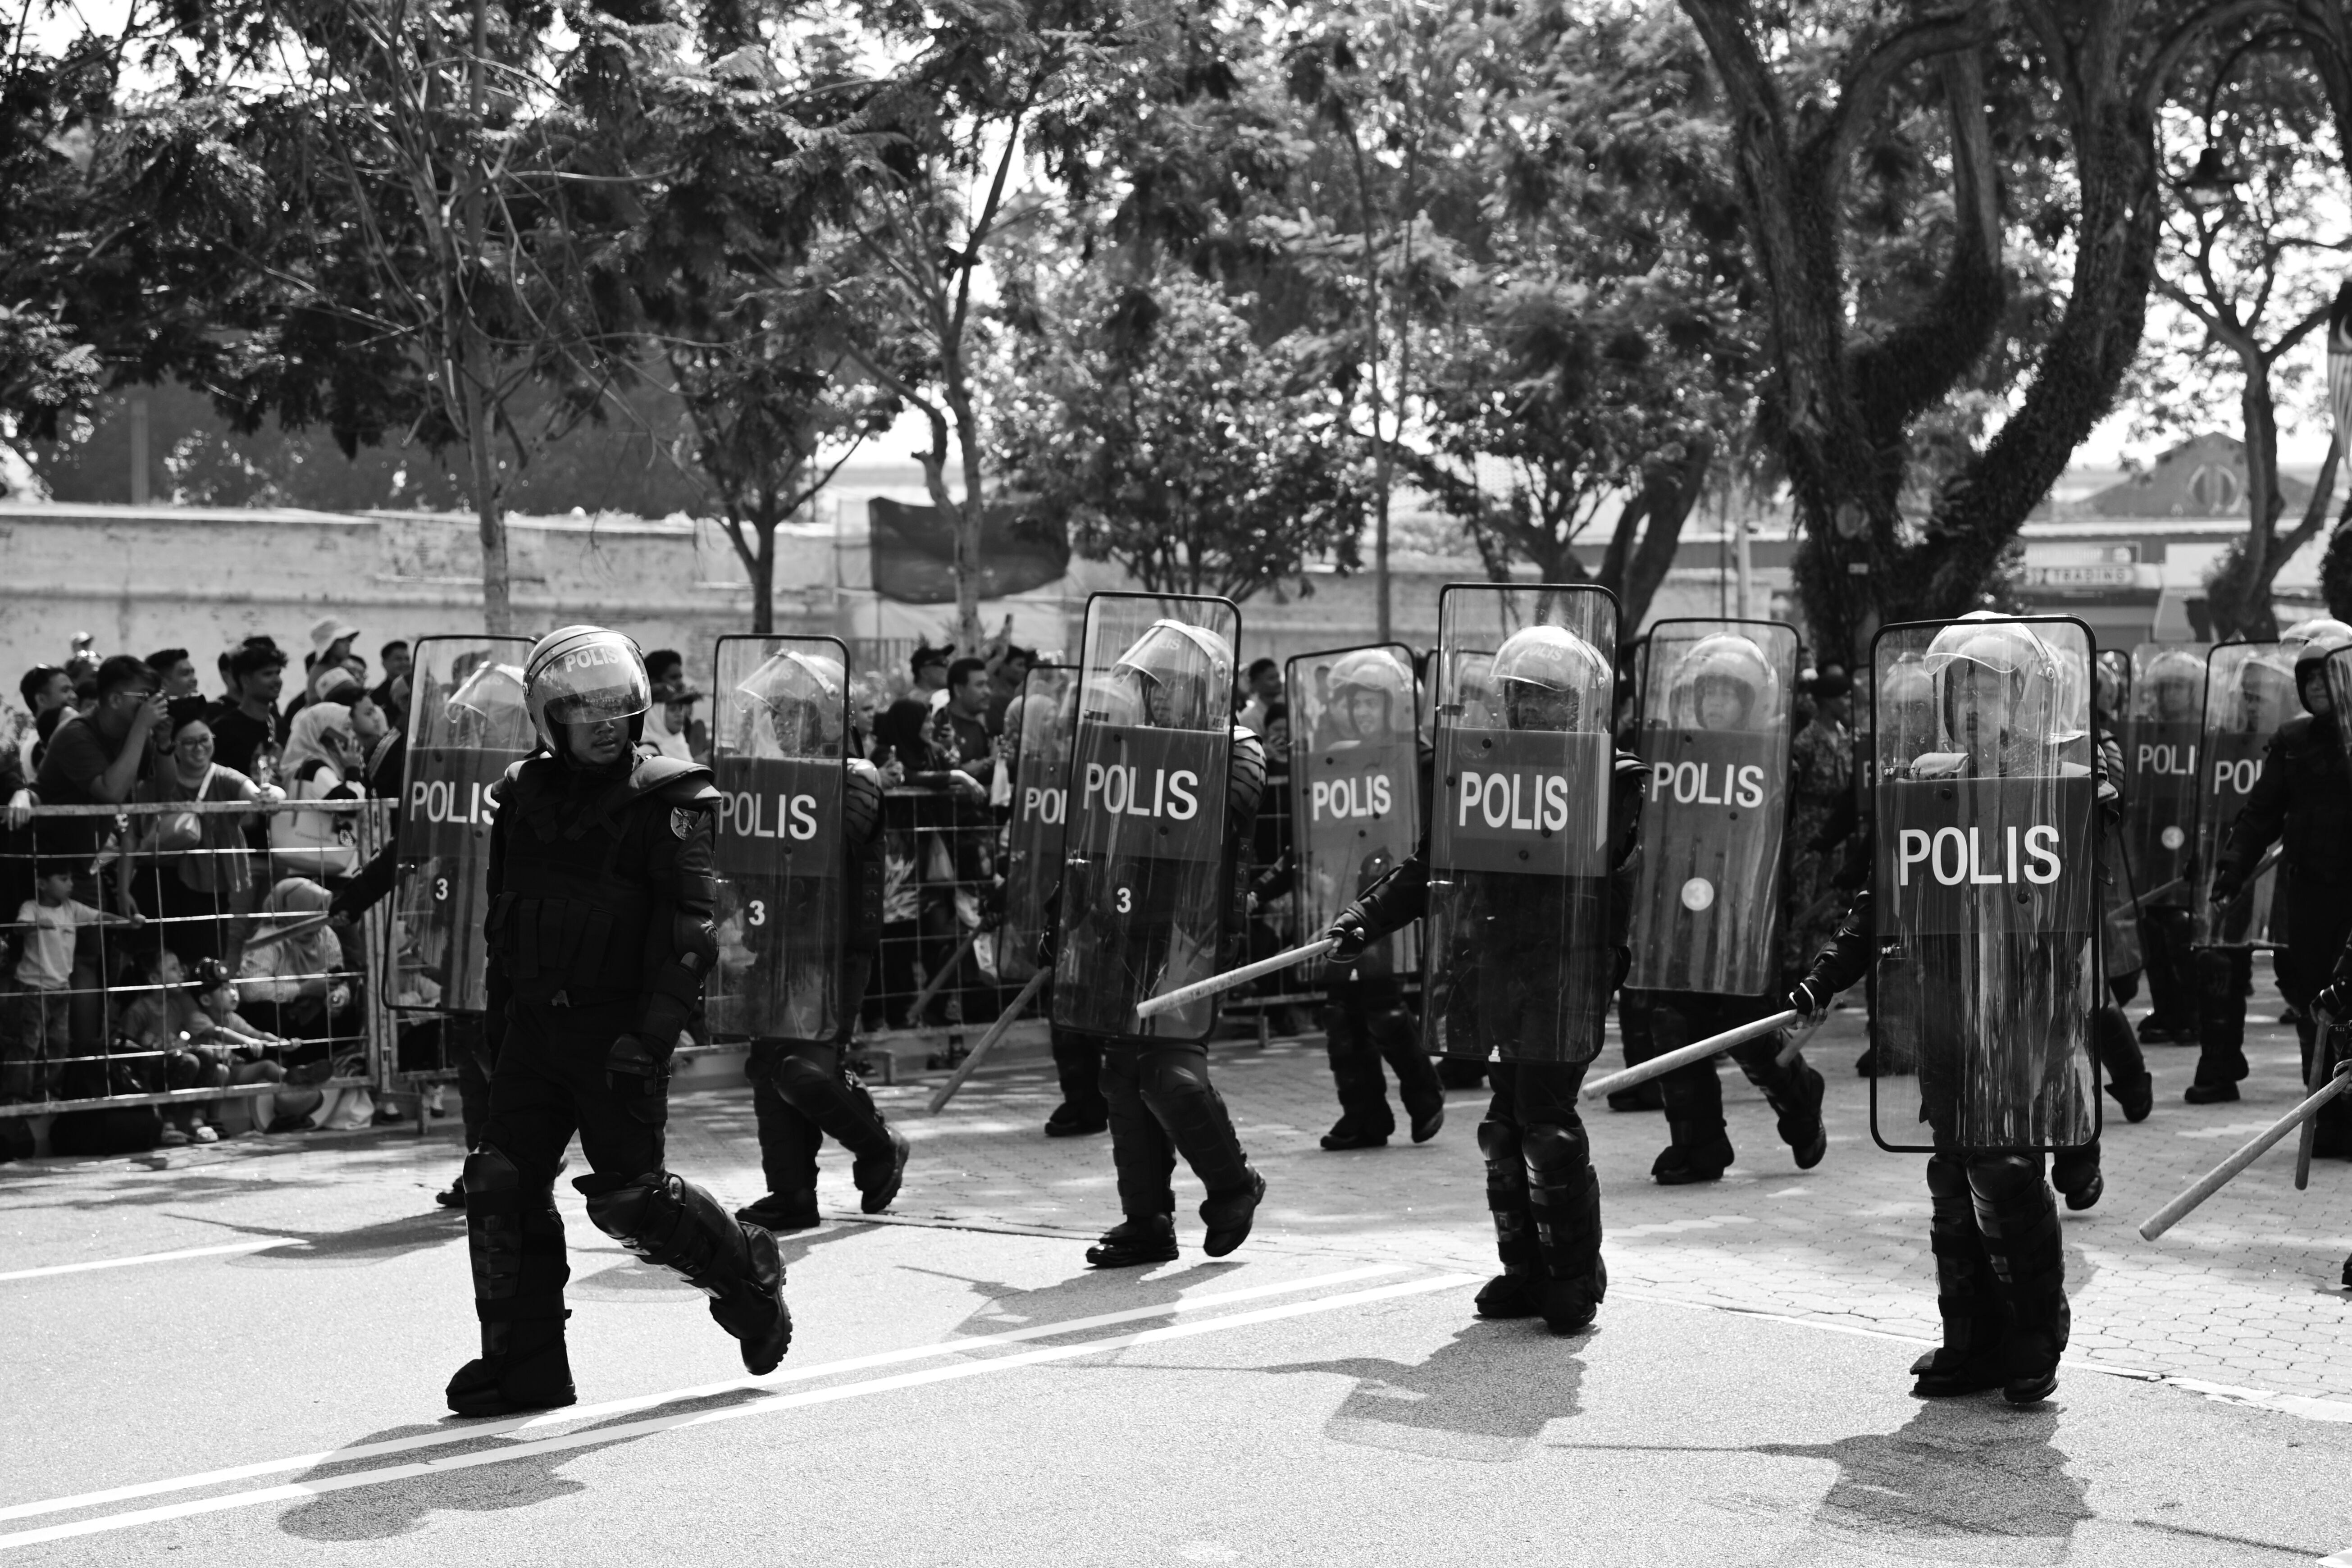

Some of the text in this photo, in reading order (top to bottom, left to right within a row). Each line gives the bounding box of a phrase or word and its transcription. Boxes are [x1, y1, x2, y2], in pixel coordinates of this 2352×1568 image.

[564, 647, 619, 673] POLIS
[1083, 762, 1198, 820] POLIS
[1312, 774, 1391, 821] POLIS
[1459, 771, 1568, 831] POLIS
[1651, 761, 1764, 808] POLIS
[719, 790, 817, 840] POLIS
[1900, 825, 2061, 886] POLIS
[435, 877, 449, 901] 3
[748, 899, 766, 926] 3
[1117, 887, 1131, 914] 3
[1688, 882, 1707, 907] 3
